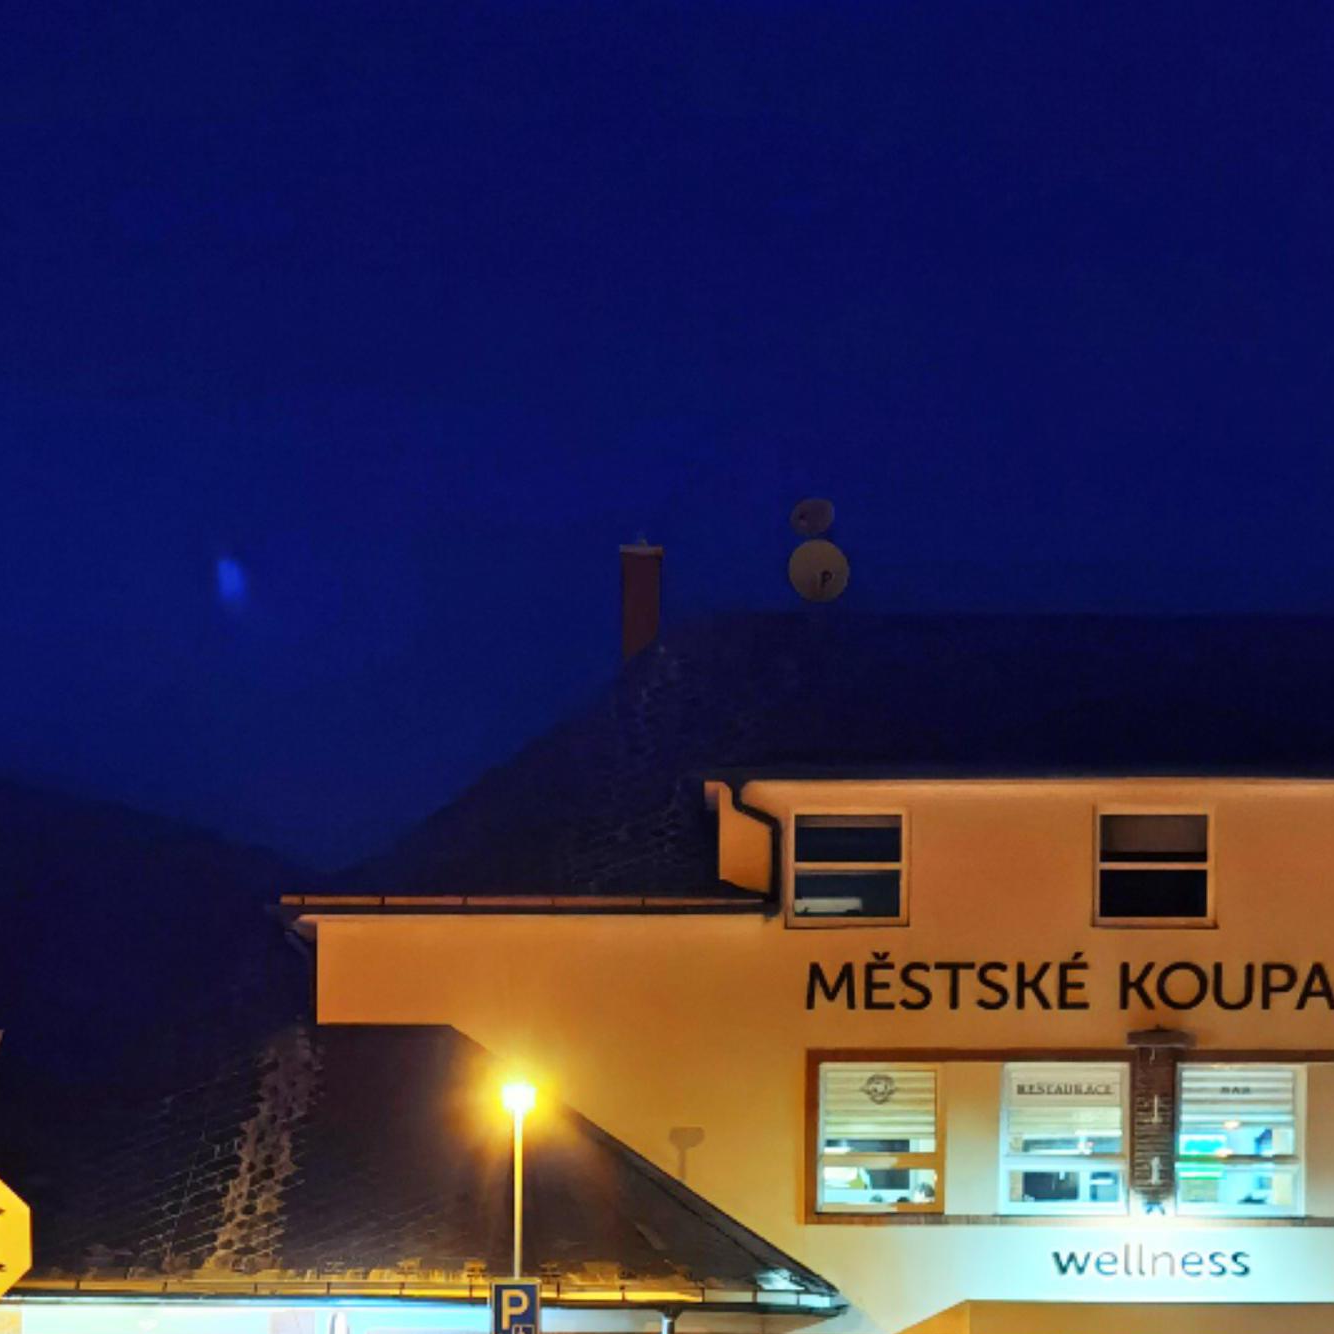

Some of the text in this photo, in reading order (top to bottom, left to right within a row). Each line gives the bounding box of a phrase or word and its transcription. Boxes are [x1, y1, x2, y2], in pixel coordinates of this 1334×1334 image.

[806, 951, 1090, 1010] MĚSTSKÉ
[1017, 1083, 1114, 1095] RESTAURACE
[1052, 1243, 1251, 1276] wellness
[502, 1289, 529, 1330] P
